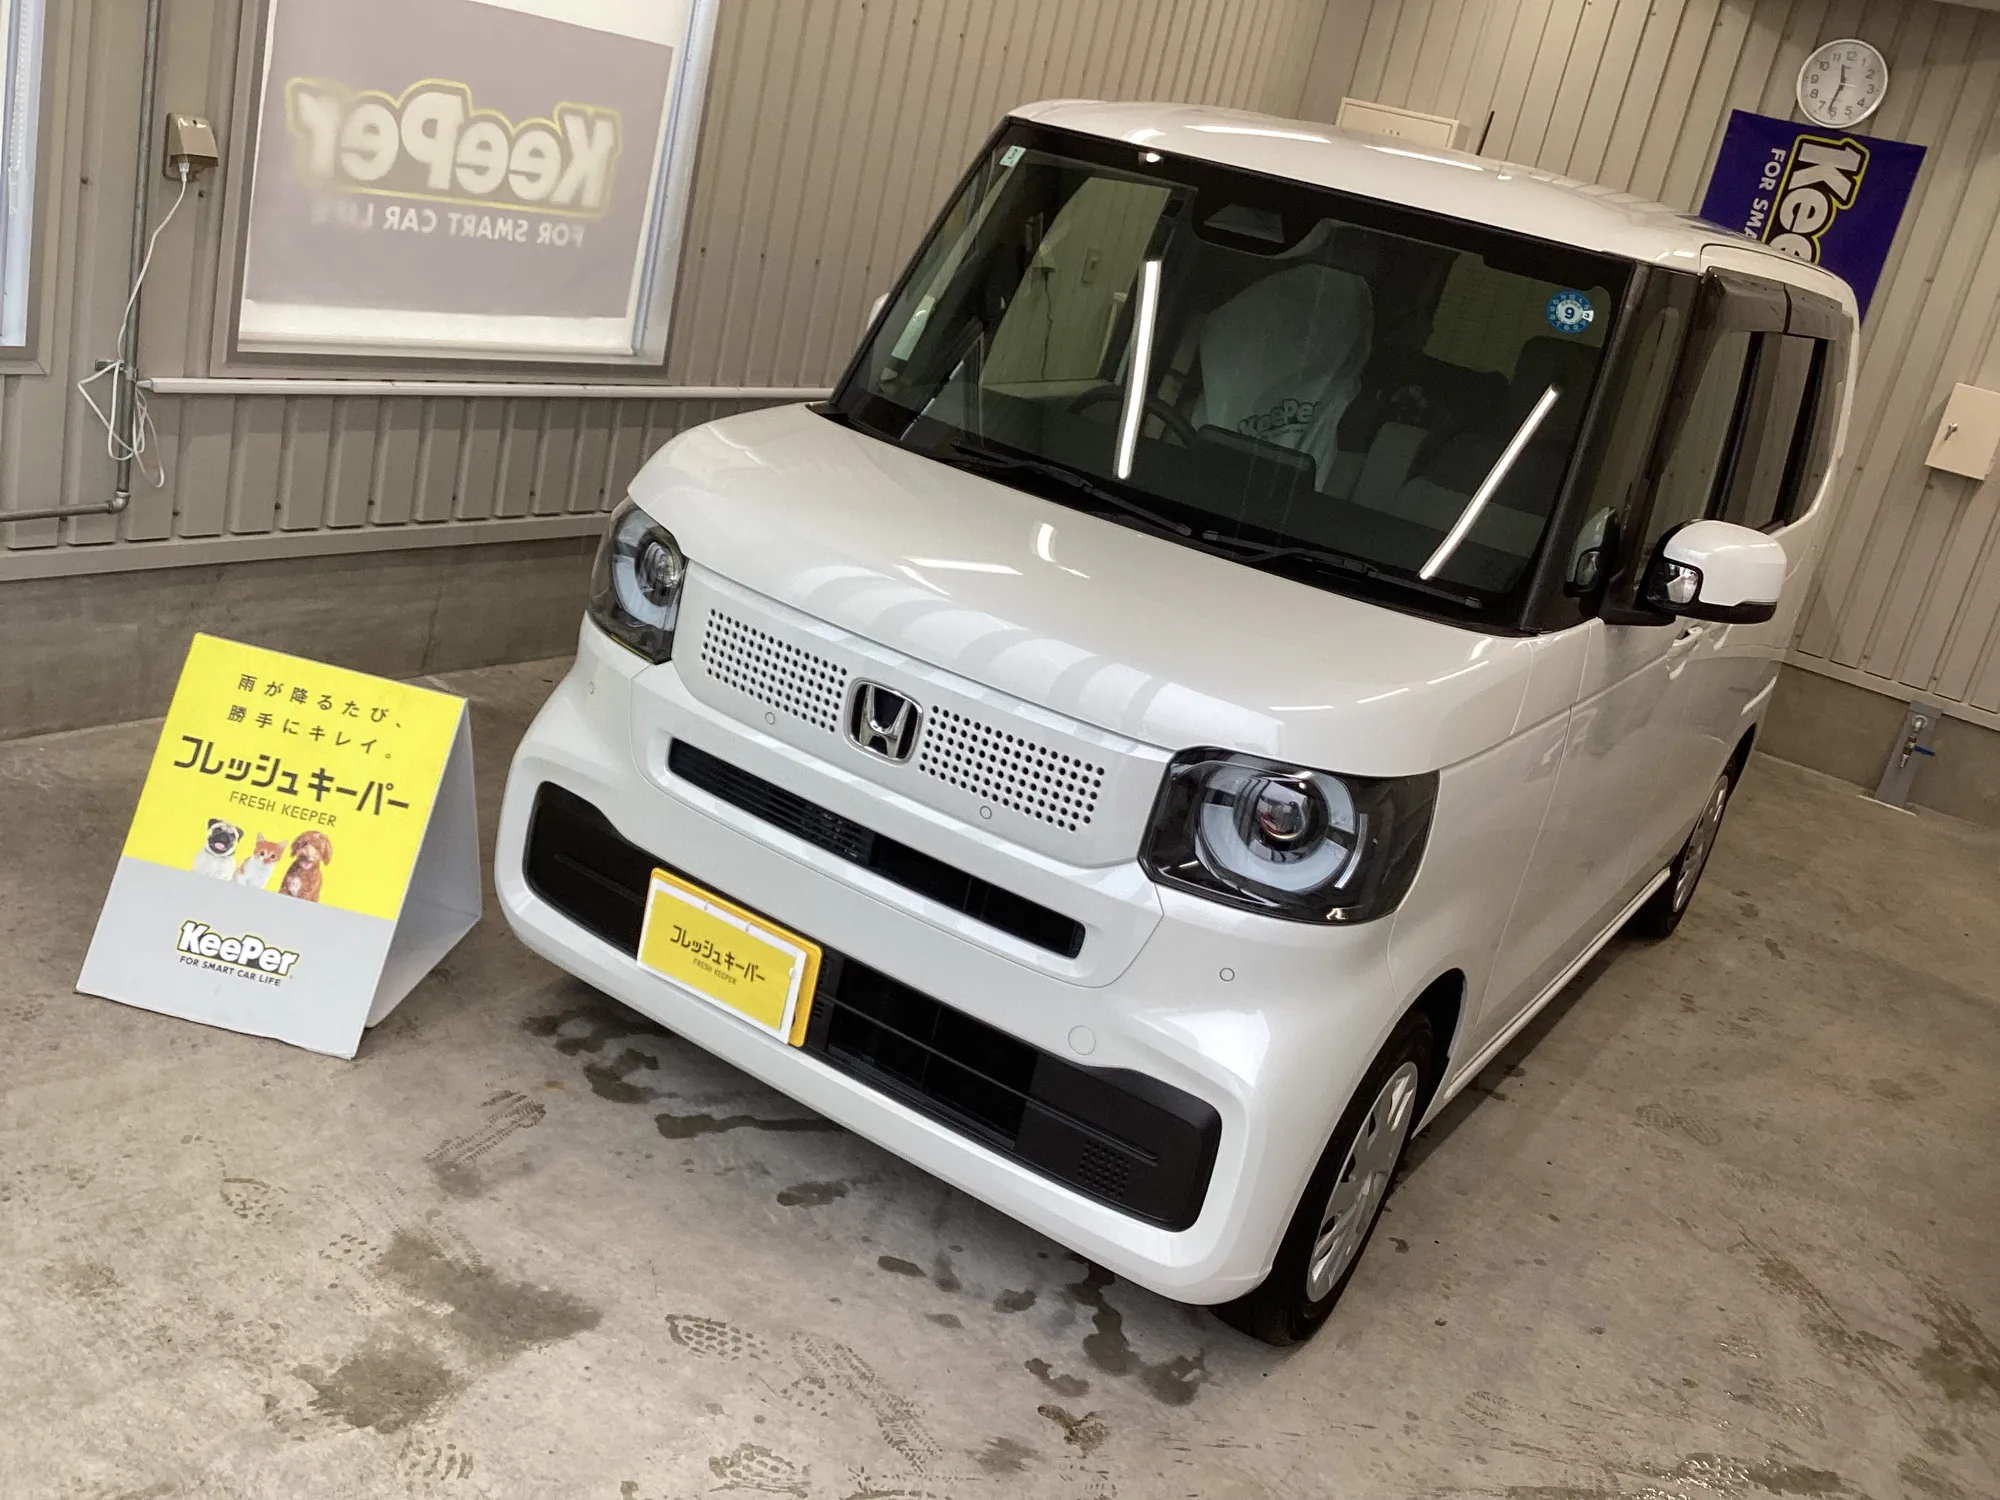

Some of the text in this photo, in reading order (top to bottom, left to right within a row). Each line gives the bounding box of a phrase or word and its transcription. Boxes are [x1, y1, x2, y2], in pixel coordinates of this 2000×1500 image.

[1810, 73, 1819, 84] 9
[1865, 69, 1876, 79] 2
[1809, 88, 1819, 98] 8
[1866, 84, 1875, 94] 3
[1819, 100, 1826, 110] 7
[1844, 105, 1853, 116] 5
[1856, 97, 1866, 107] 4
[1828, 106, 1838, 117] 6
[1758, 148, 1787, 191] FOR
[1564, 306, 1575, 319] 9
[1238, 398, 1321, 437] KeePe
[237, 673, 403, 729] 雨が降るたび、
[227, 703, 392, 760] 勝手にキレイ。
[173, 734, 411, 817] フレッシュキーパー
[229, 790, 337, 828] FRESH KEEPER
[177, 919, 300, 977] KeePer
[669, 923, 766, 983] フレッシュキーパー
[179, 955, 282, 987] FOR SMART CAR LIFE
[692, 957, 713, 974] FRESH
